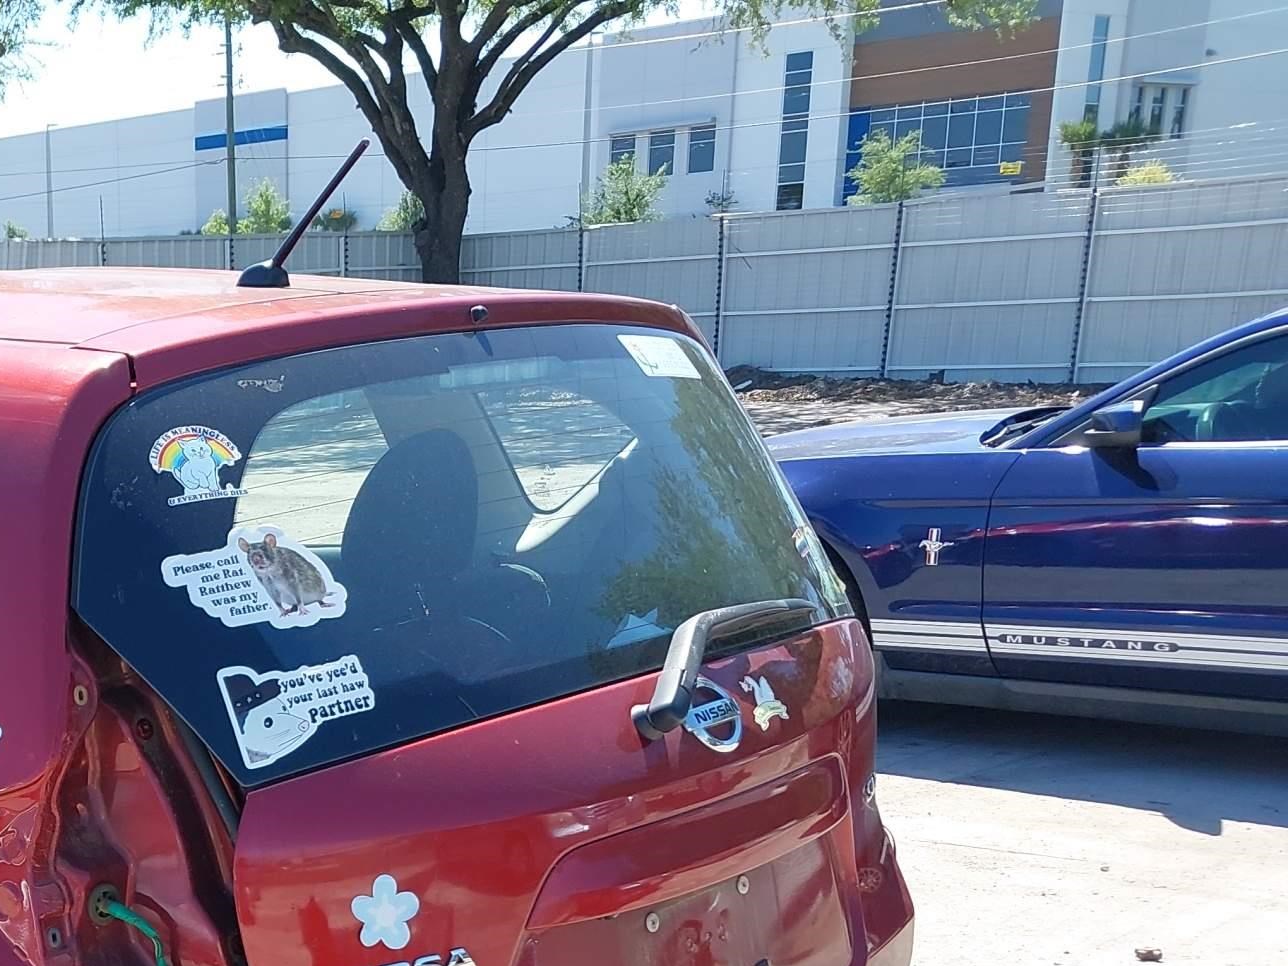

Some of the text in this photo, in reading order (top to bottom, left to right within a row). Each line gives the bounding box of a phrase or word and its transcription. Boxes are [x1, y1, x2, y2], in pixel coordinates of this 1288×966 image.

[151, 426, 235, 460] LIFE IS MEANINGLESS
[177, 490, 229, 503] EVERYTHING
[230, 488, 249, 496] DIES
[172, 554, 240, 577] Please, call
[200, 567, 247, 583] me Rat.
[198, 579, 252, 597] Ratthew
[211, 591, 259, 607] was my
[229, 601, 273, 617] father.
[1006, 635, 1171, 652] MUSTANG
[280, 662, 358, 693] you've yee'd
[286, 680, 365, 708] your last haw
[694, 699, 739, 724] NISSAN
